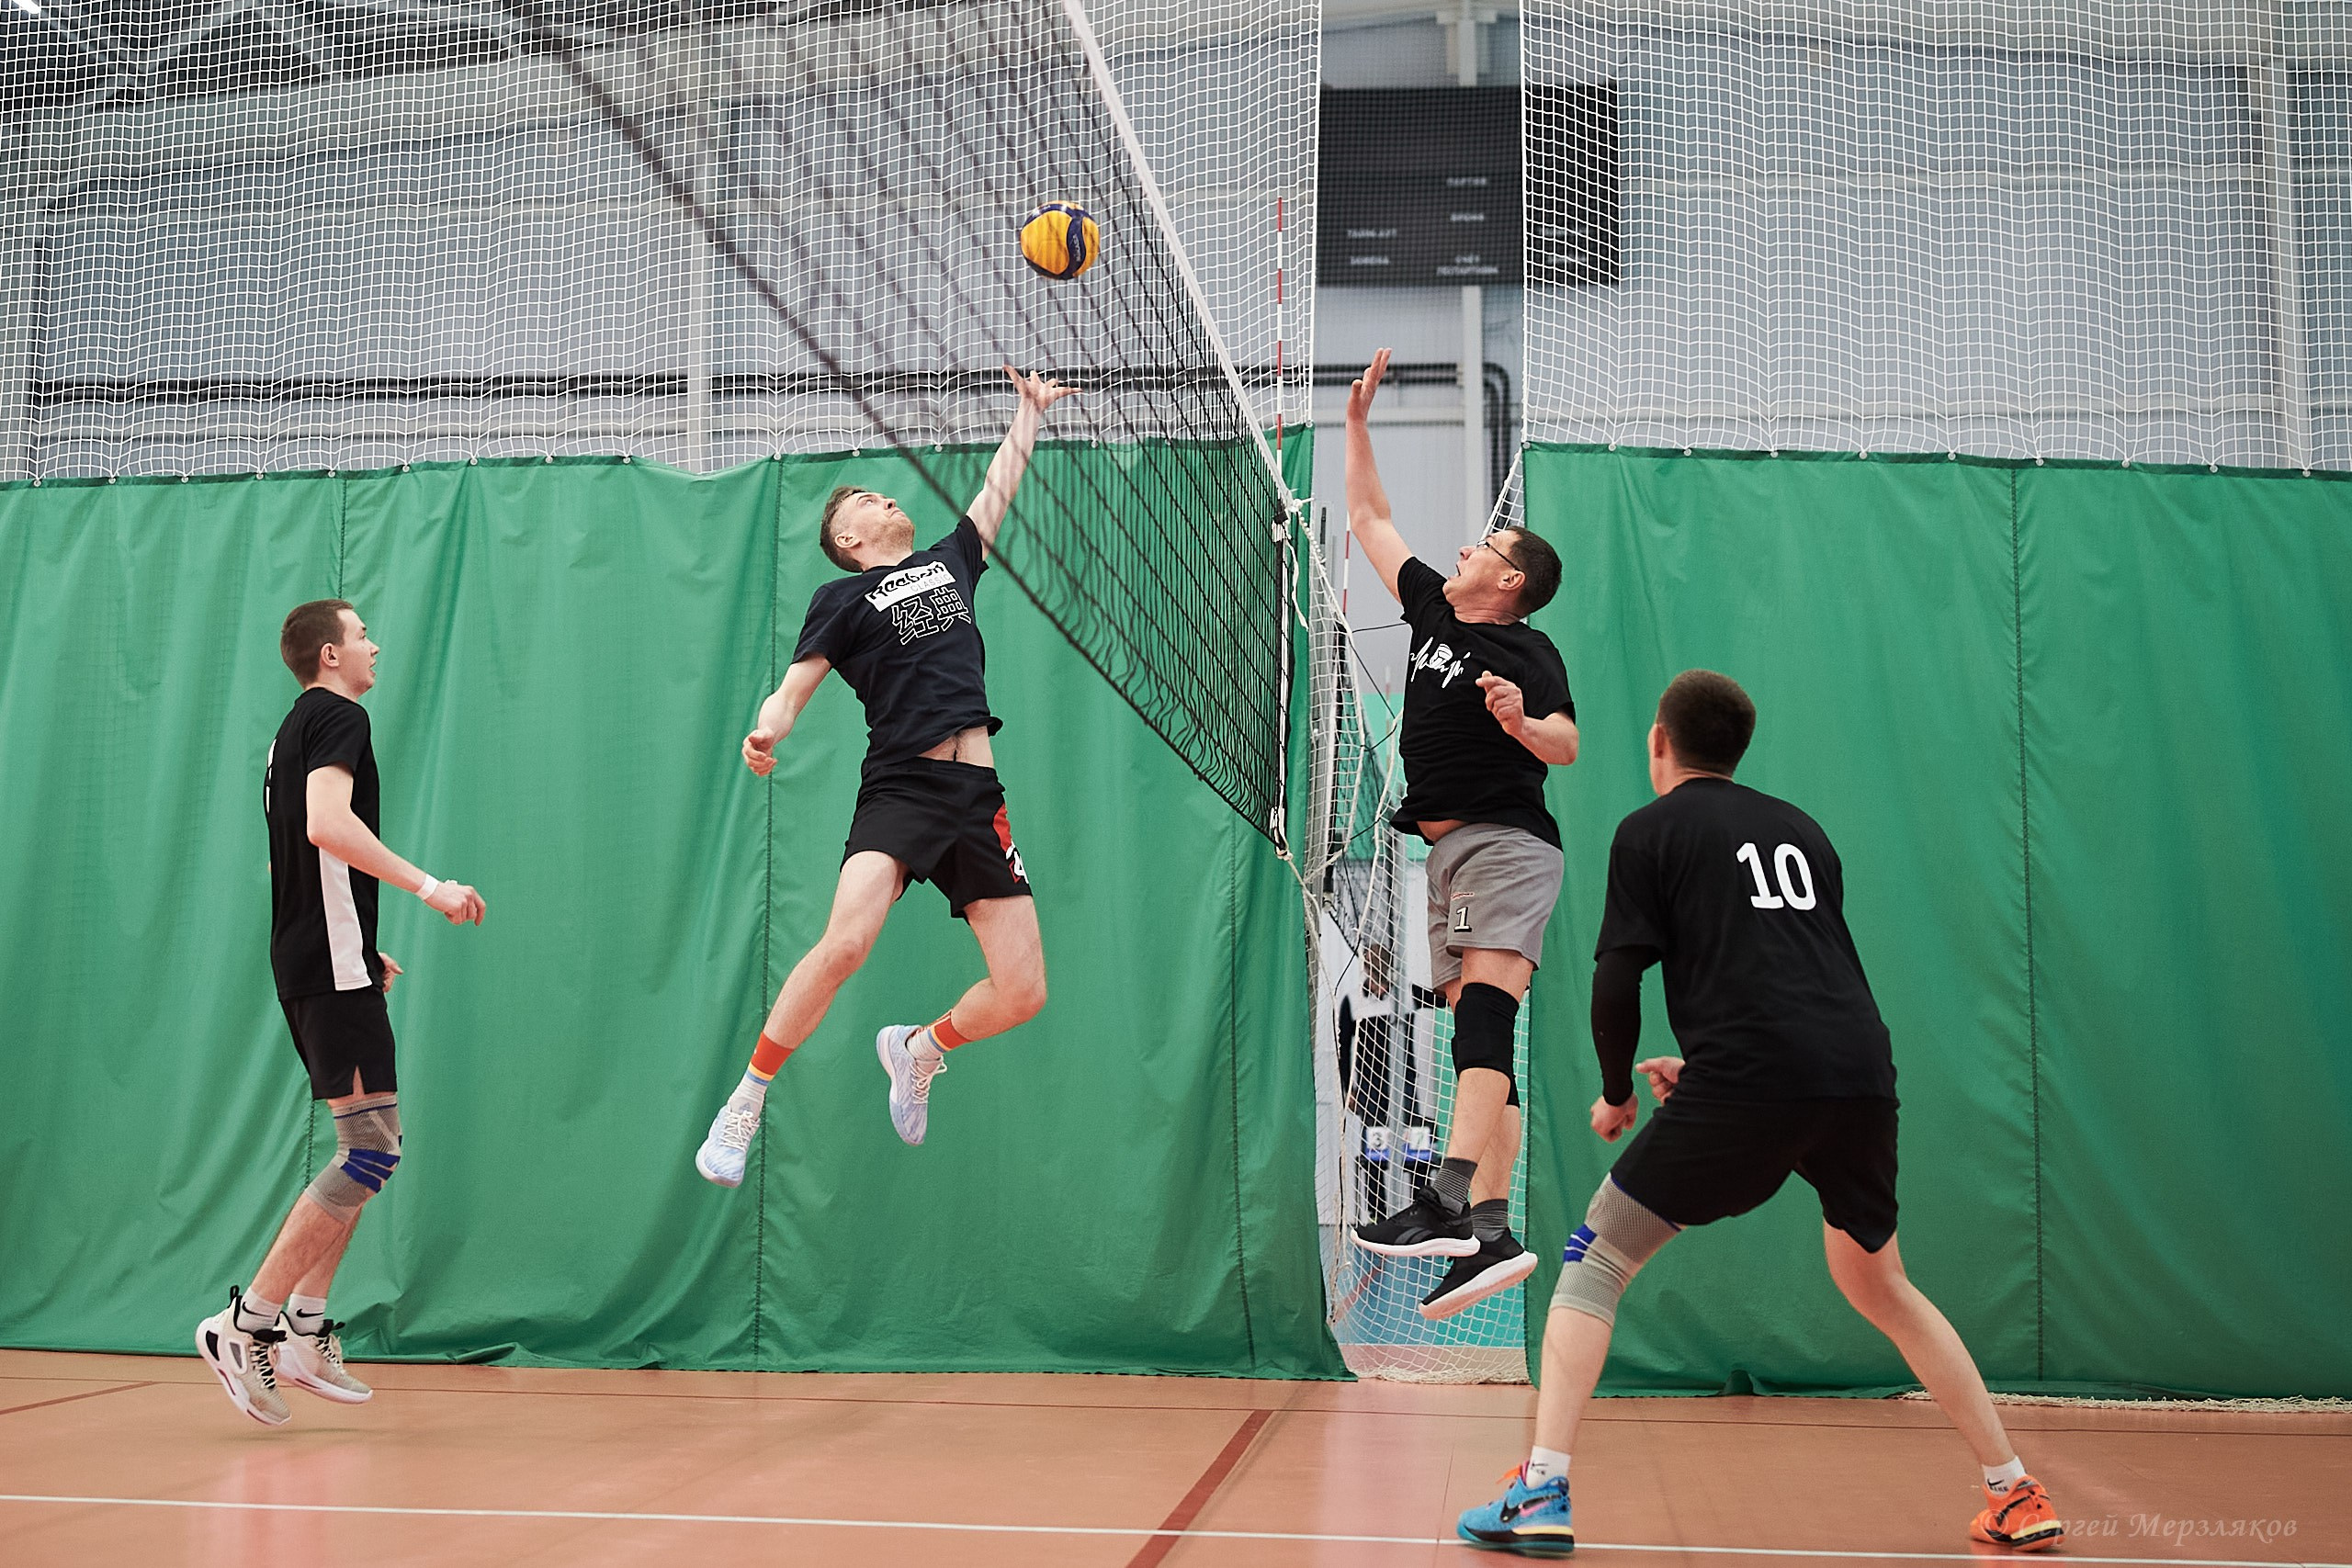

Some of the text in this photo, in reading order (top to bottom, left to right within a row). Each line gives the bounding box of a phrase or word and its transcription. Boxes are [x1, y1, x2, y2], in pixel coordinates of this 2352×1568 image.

[910, 573, 952, 592] CLASSIC
[891, 588, 972, 645] 经典
[1736, 841, 1817, 911] 10
[1453, 906, 1473, 933] 1
